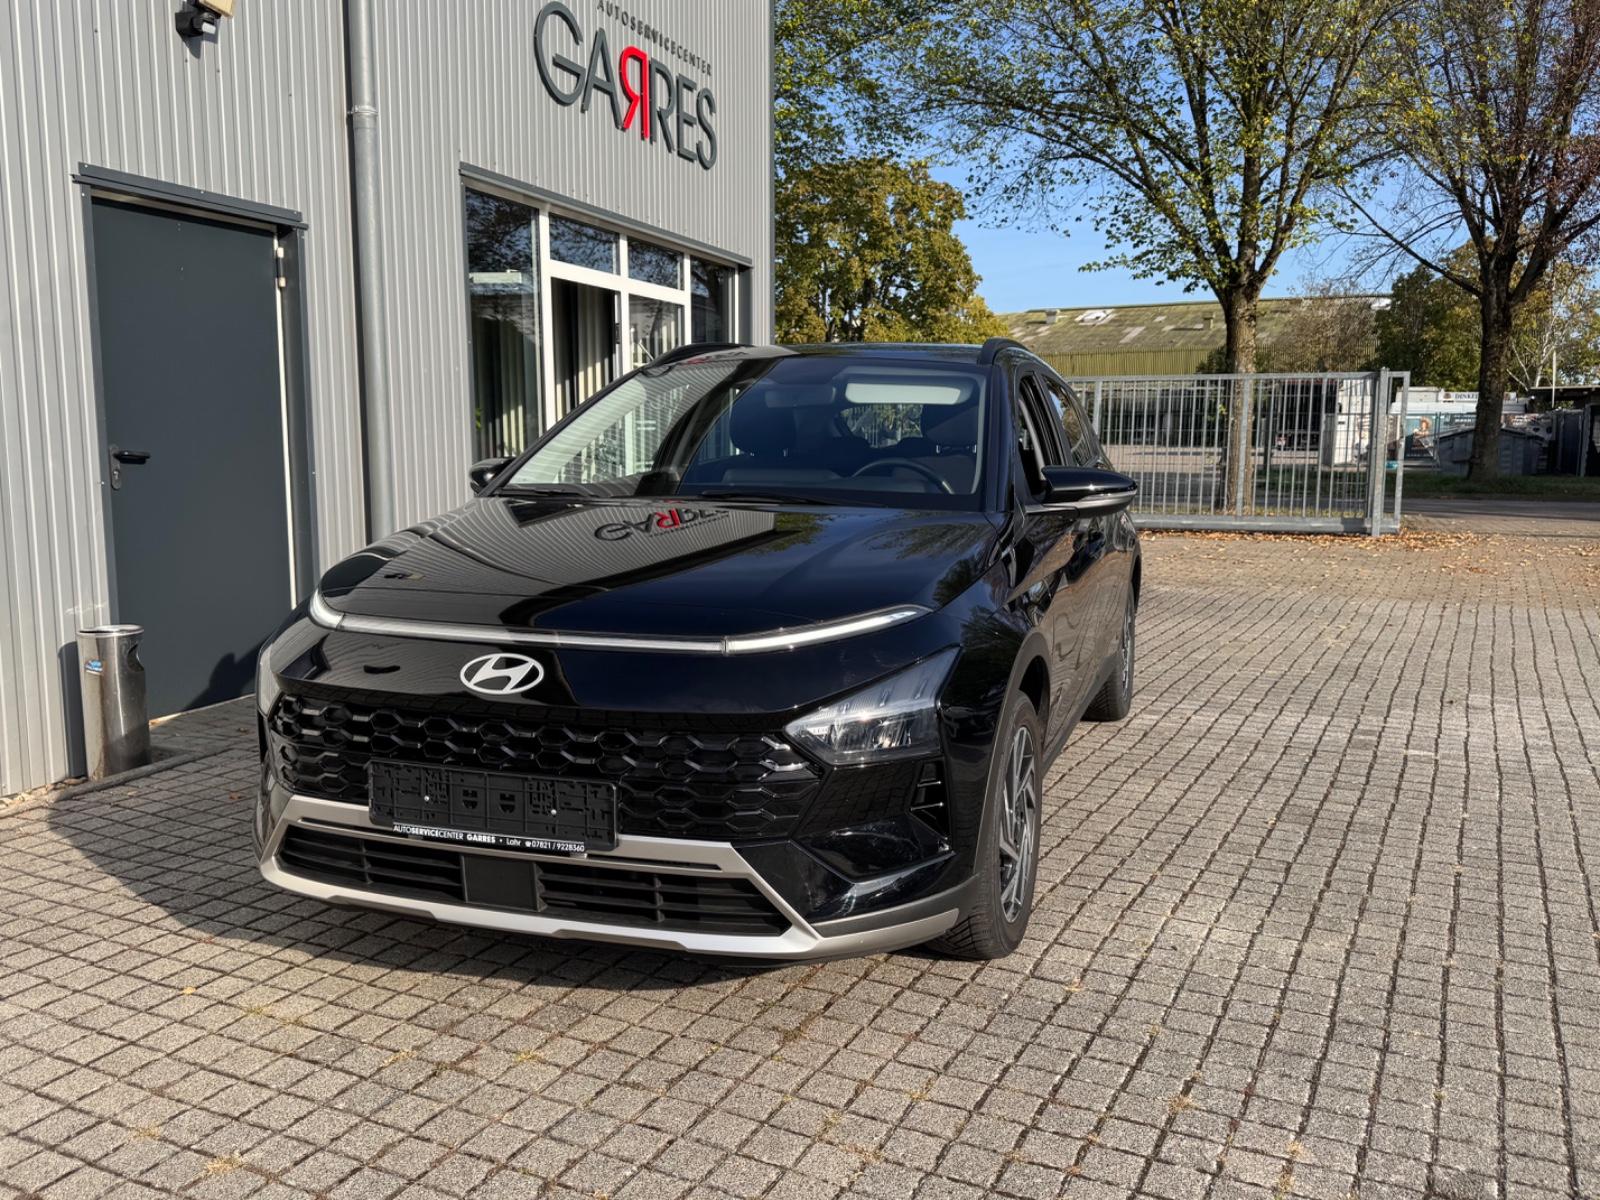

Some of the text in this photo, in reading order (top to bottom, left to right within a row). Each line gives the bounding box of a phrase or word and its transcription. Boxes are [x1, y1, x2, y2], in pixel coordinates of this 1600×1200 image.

[597, 0, 711, 76] AUTOSERVICECENTER
[533, 1, 717, 170] GARRES
[393, 825, 463, 840] AUTOSERVICECENTER
[466, 834, 496, 843] GARRES
